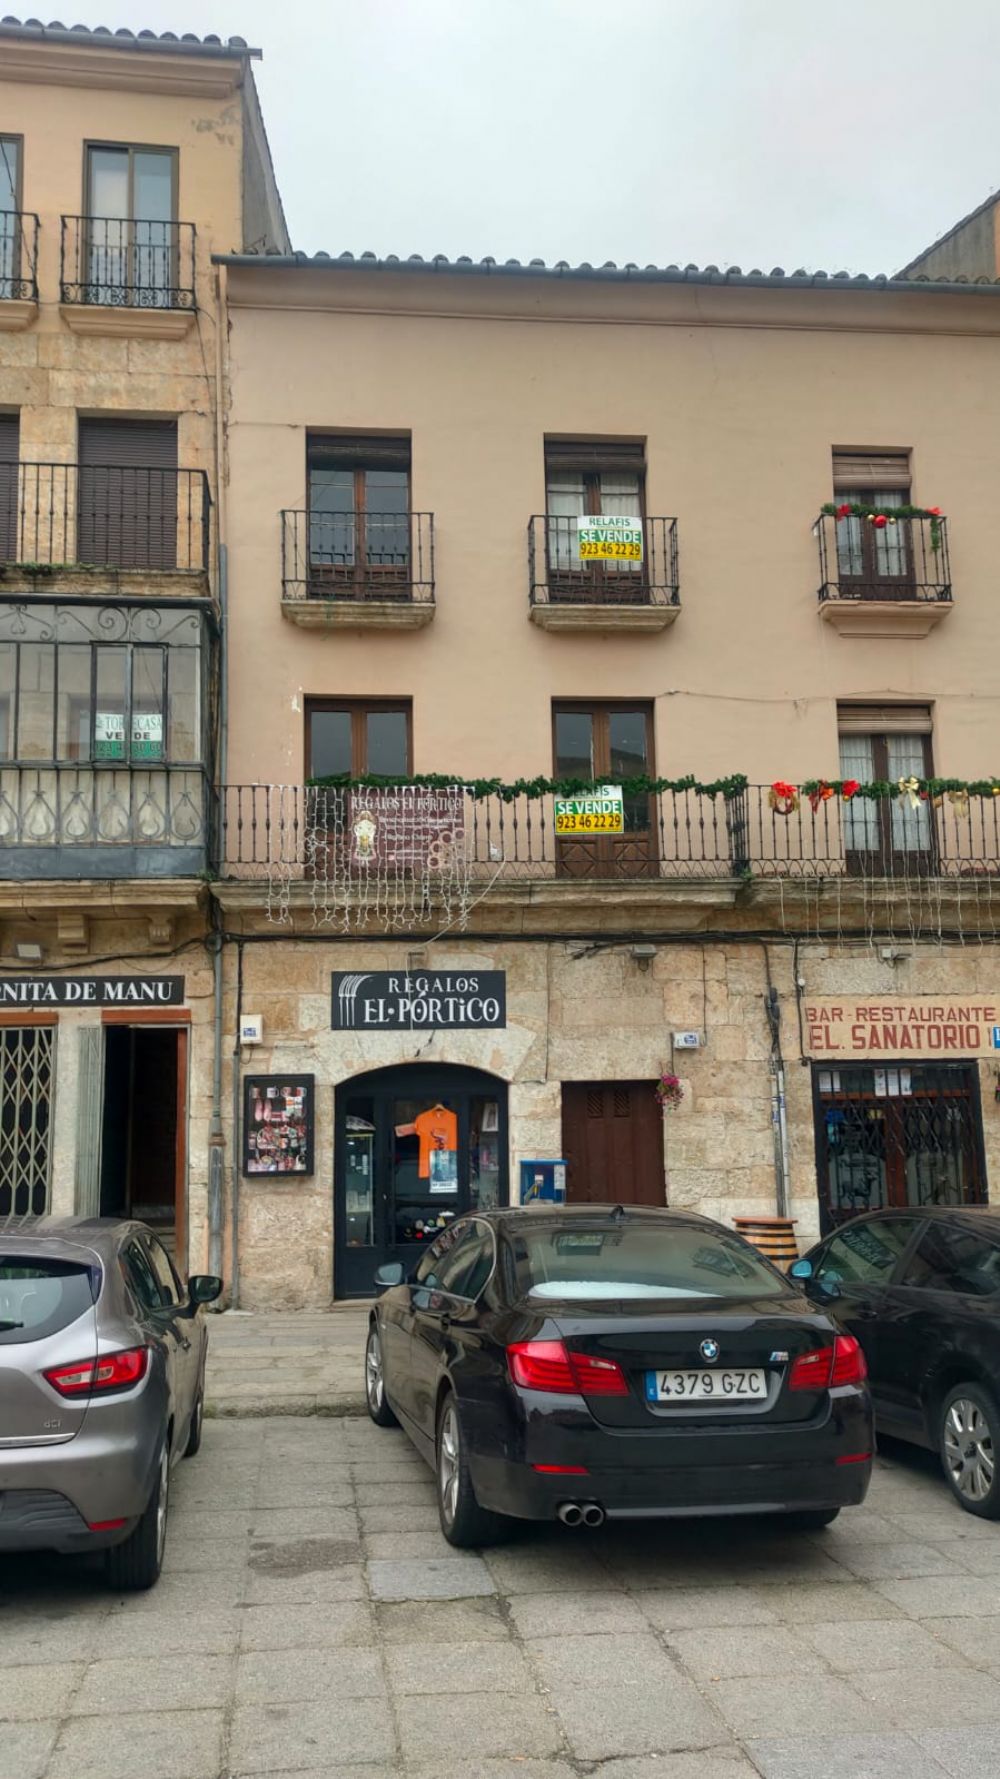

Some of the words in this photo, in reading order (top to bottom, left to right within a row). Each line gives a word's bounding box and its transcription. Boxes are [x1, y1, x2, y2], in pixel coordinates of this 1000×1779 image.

[589, 517, 630, 526] RELAFIS
[581, 530, 595, 542] SE
[598, 530, 640, 543] VENDE
[580, 543, 598, 554] 923
[601, 543, 613, 554] 46
[615, 543, 626, 555] 22
[629, 544, 640, 556] 29
[558, 801, 573, 814] SE
[575, 801, 619, 814] VENDE
[557, 816, 576, 829] 923
[579, 815, 591, 828] 46
[594, 815, 606, 828] 22
[608, 814, 621, 828] 29
[64, 982, 96, 1000] DE
[103, 982, 173, 1000] MANU
[388, 977, 479, 993] REGALOS
[852, 1024, 981, 1050] SANATORIO
[661, 1373, 714, 1395] 4379
[722, 1373, 760, 1393] GZC
